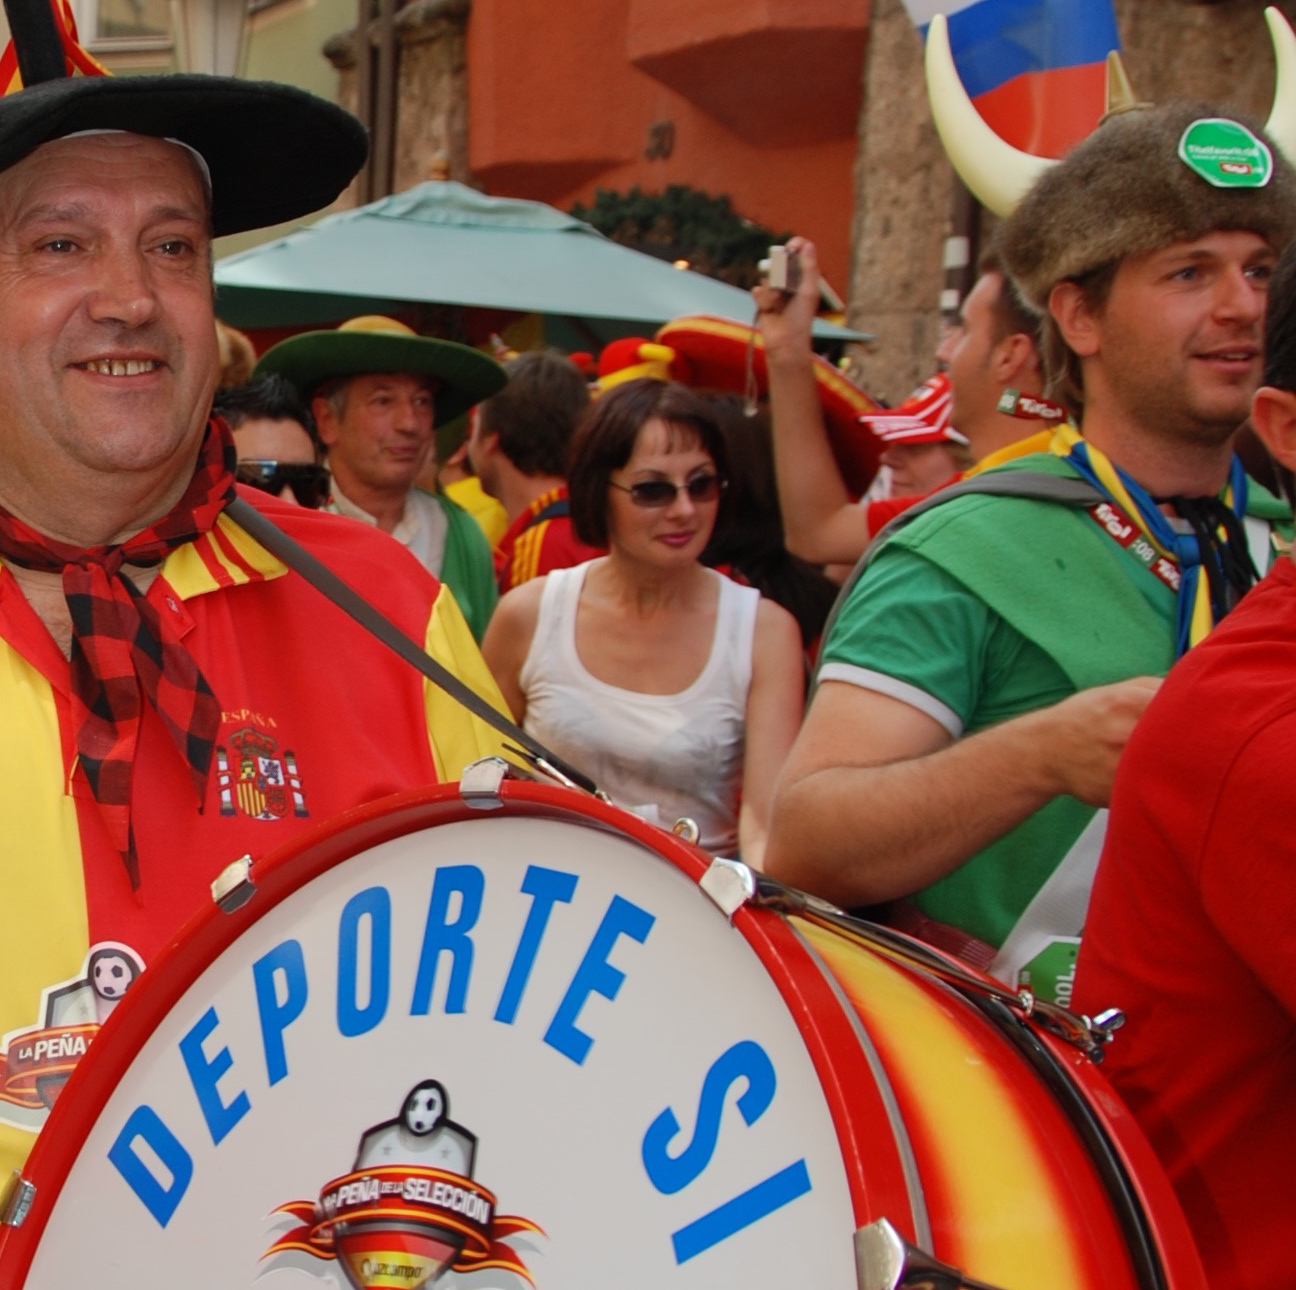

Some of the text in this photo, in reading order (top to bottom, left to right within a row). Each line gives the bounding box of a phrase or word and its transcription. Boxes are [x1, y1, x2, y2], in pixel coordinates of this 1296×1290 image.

[1095, 503, 1133, 539] Tirol
[1132, 539, 1155, 561] :08
[18, 1033, 87, 1061] LA PEÑA
[108, 864, 813, 1264] DEPORTE SI
[337, 1176, 380, 1208] PEÑA
[402, 1177, 492, 1225] SELECCIÓN
